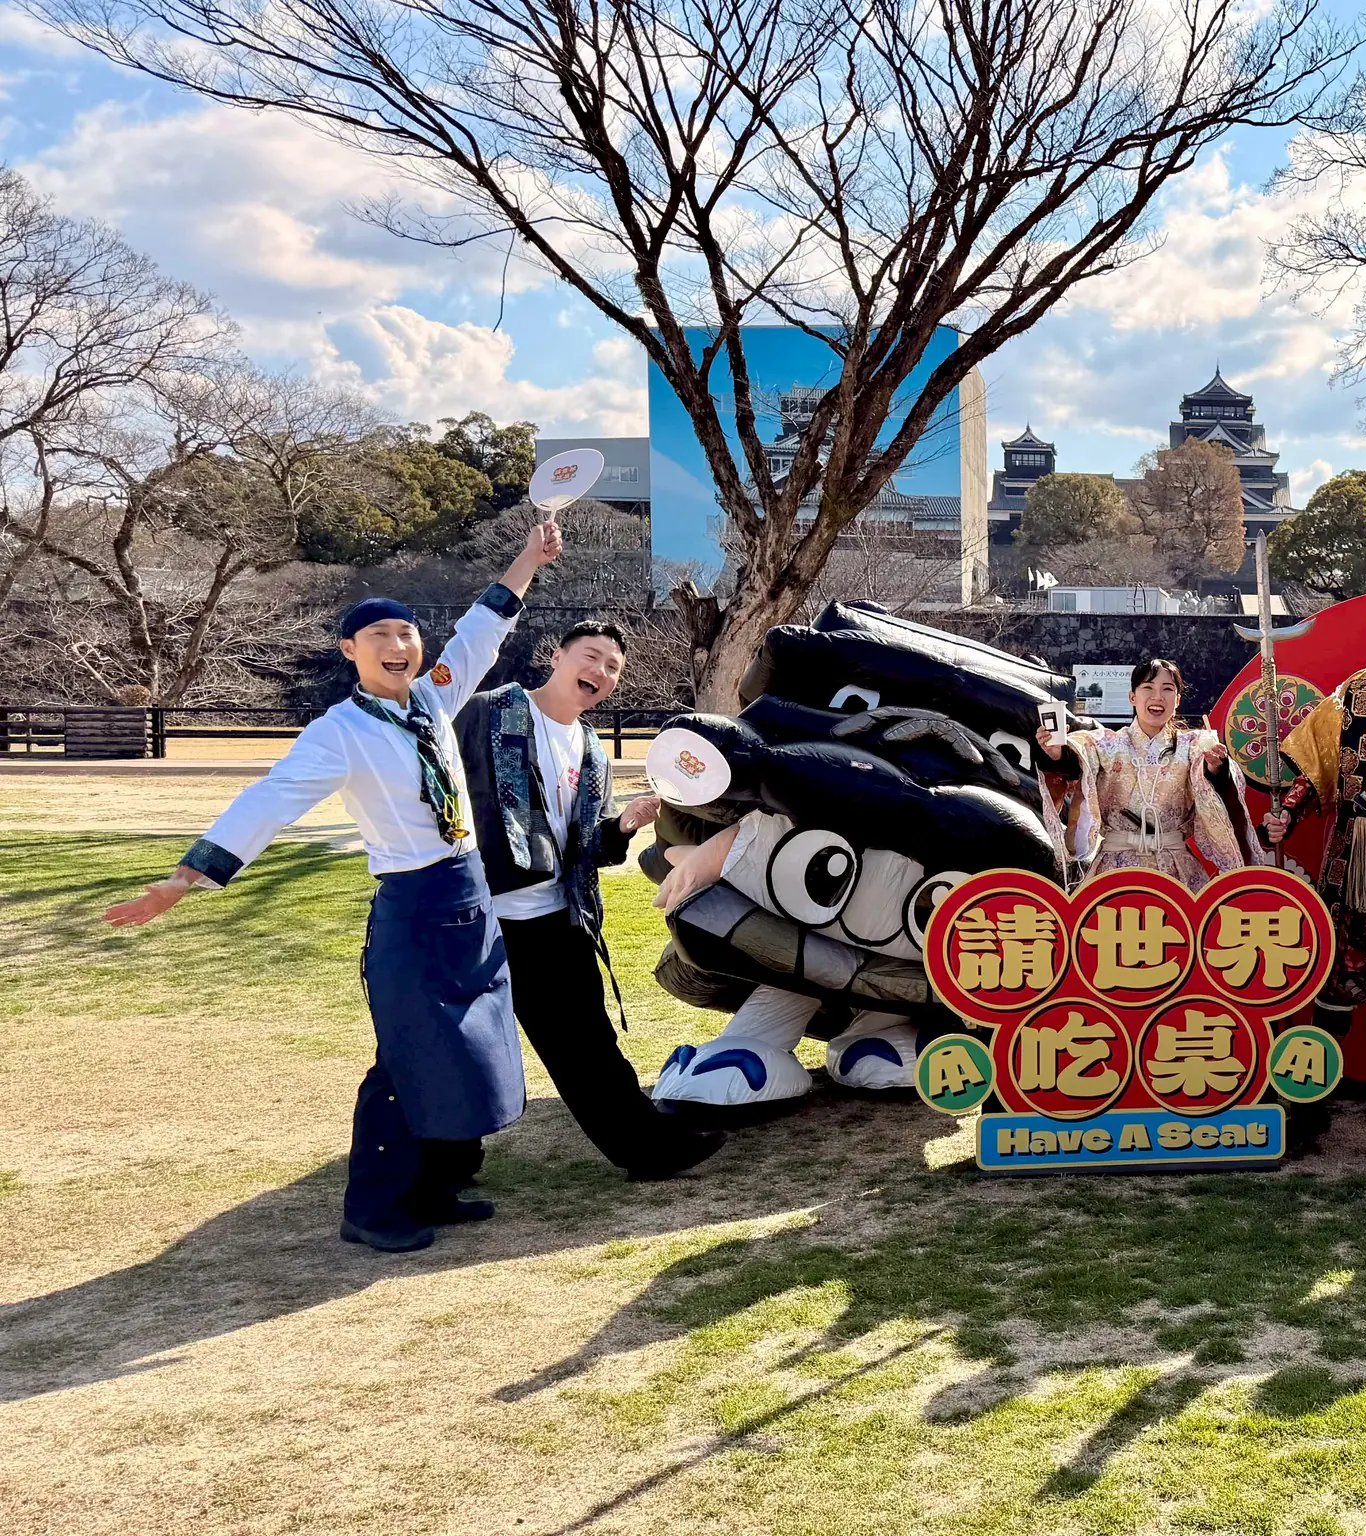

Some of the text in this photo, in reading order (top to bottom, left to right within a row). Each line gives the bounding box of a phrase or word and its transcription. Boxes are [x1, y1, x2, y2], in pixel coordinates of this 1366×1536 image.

[954, 904, 1311, 990] 請世界
[1018, 1009, 1246, 1098] 吃桌
[997, 1121, 1268, 1155] Have A Seat
